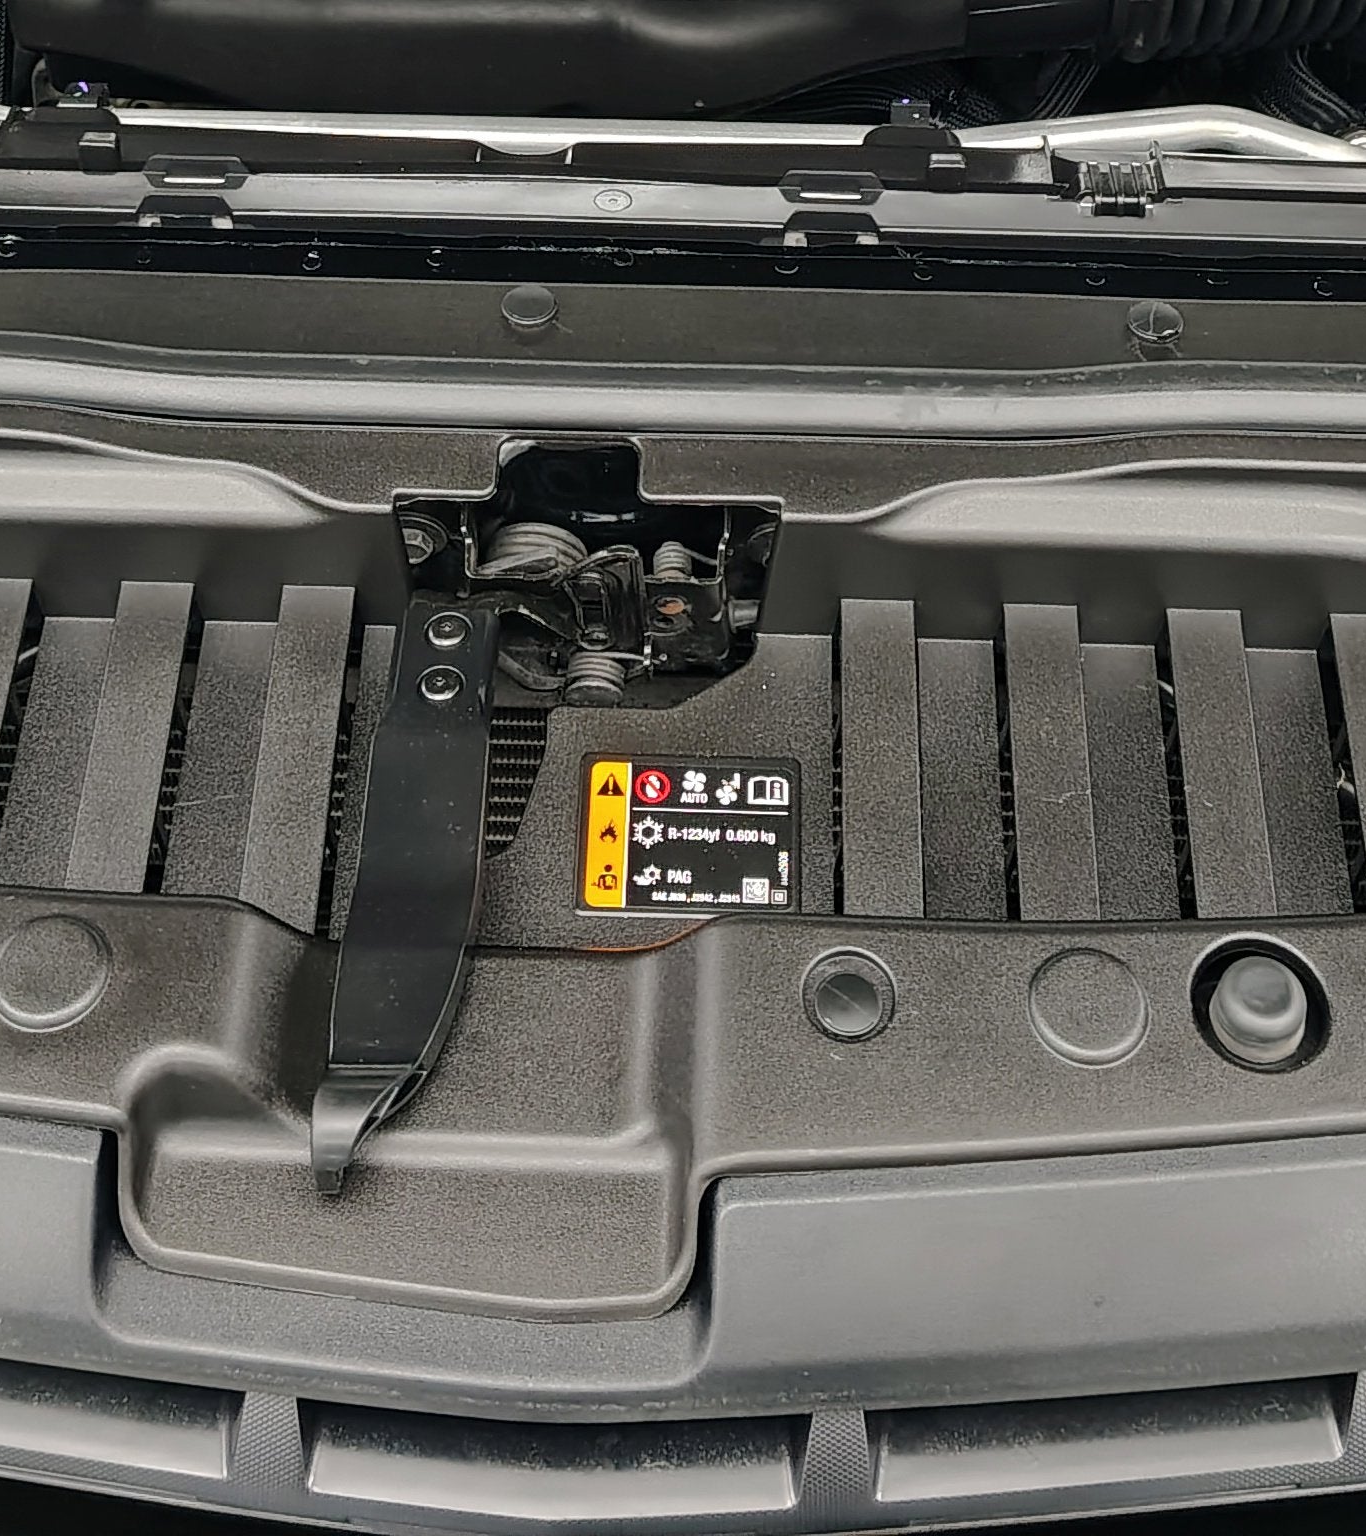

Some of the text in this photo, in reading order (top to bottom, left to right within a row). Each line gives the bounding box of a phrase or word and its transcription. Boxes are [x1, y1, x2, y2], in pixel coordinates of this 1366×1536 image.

[680, 792, 708, 804] AUTO
[726, 829, 758, 842] 0.600
[760, 830, 776, 845] kg
[667, 868, 692, 884] PAG
